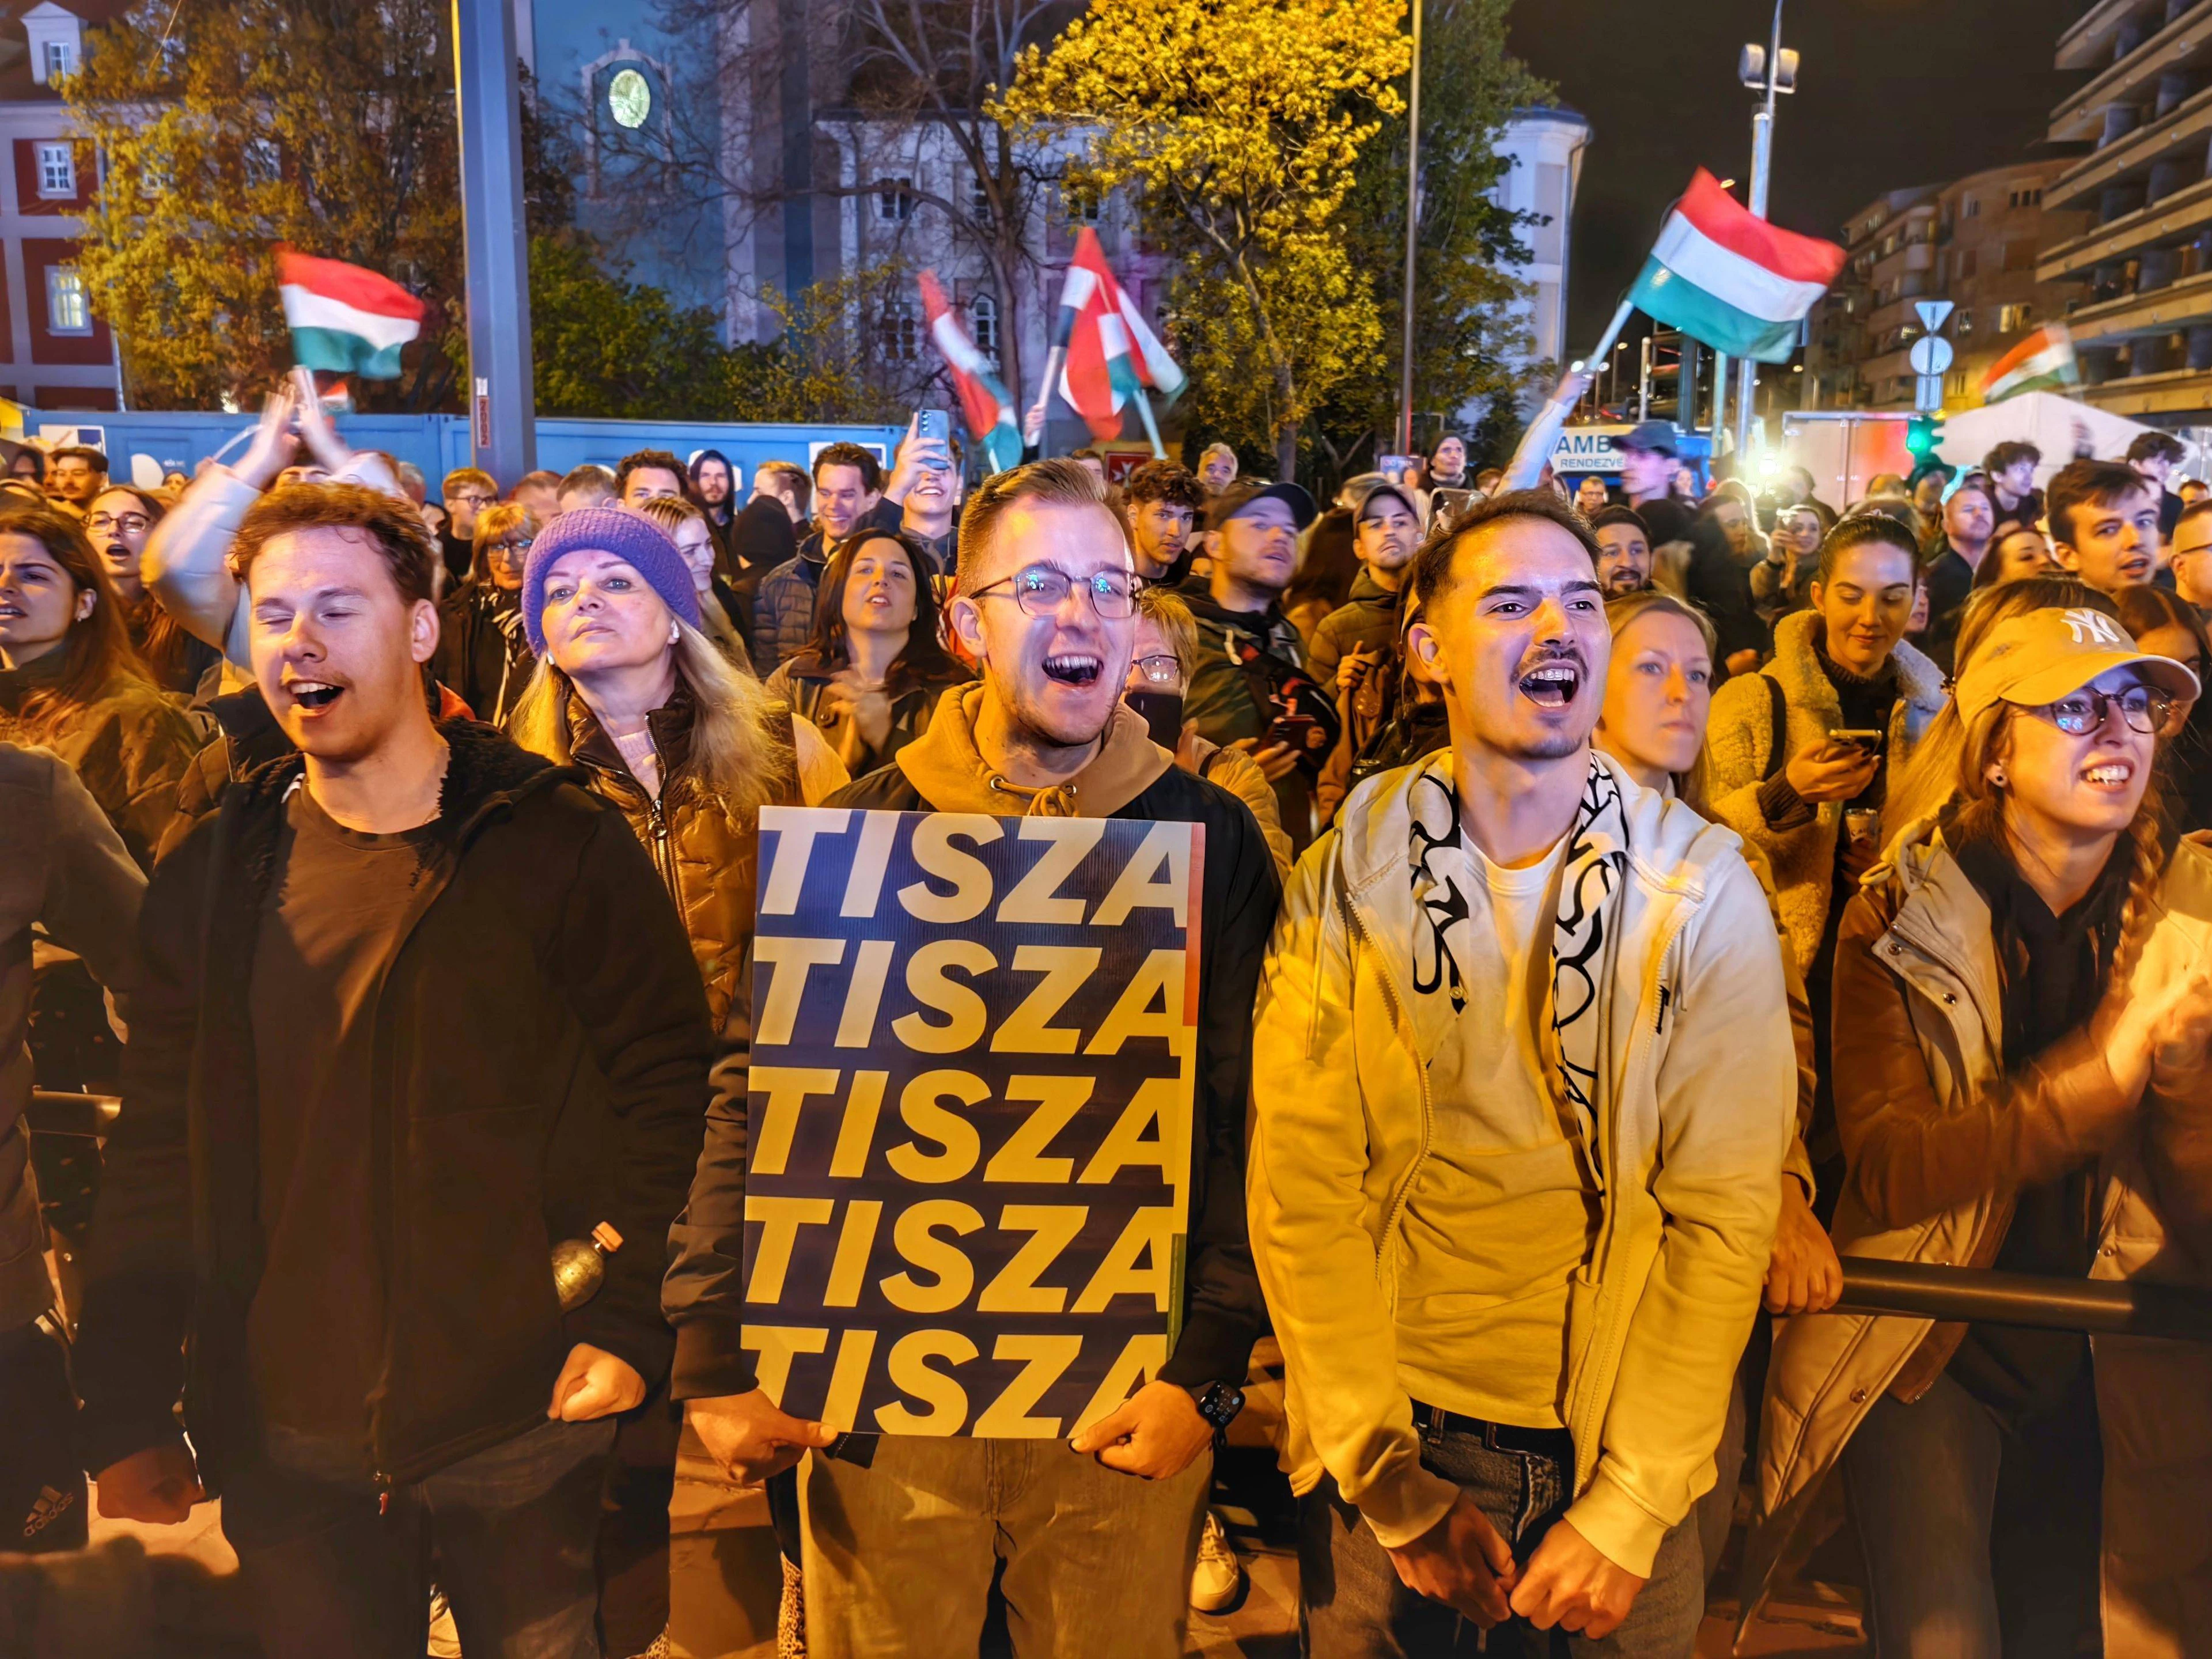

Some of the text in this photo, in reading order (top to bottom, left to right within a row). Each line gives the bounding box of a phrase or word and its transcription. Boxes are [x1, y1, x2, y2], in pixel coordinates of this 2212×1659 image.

[1555, 435, 1612, 454] AMB
[1560, 456, 1623, 468] RENDEZVÉ
[2060, 608, 2120, 643] NY
[759, 805, 1191, 928] TISZA
[753, 936, 1186, 1057] TISZA
[748, 1066, 1180, 1184] TISZA
[745, 1195, 1174, 1313] TISZA
